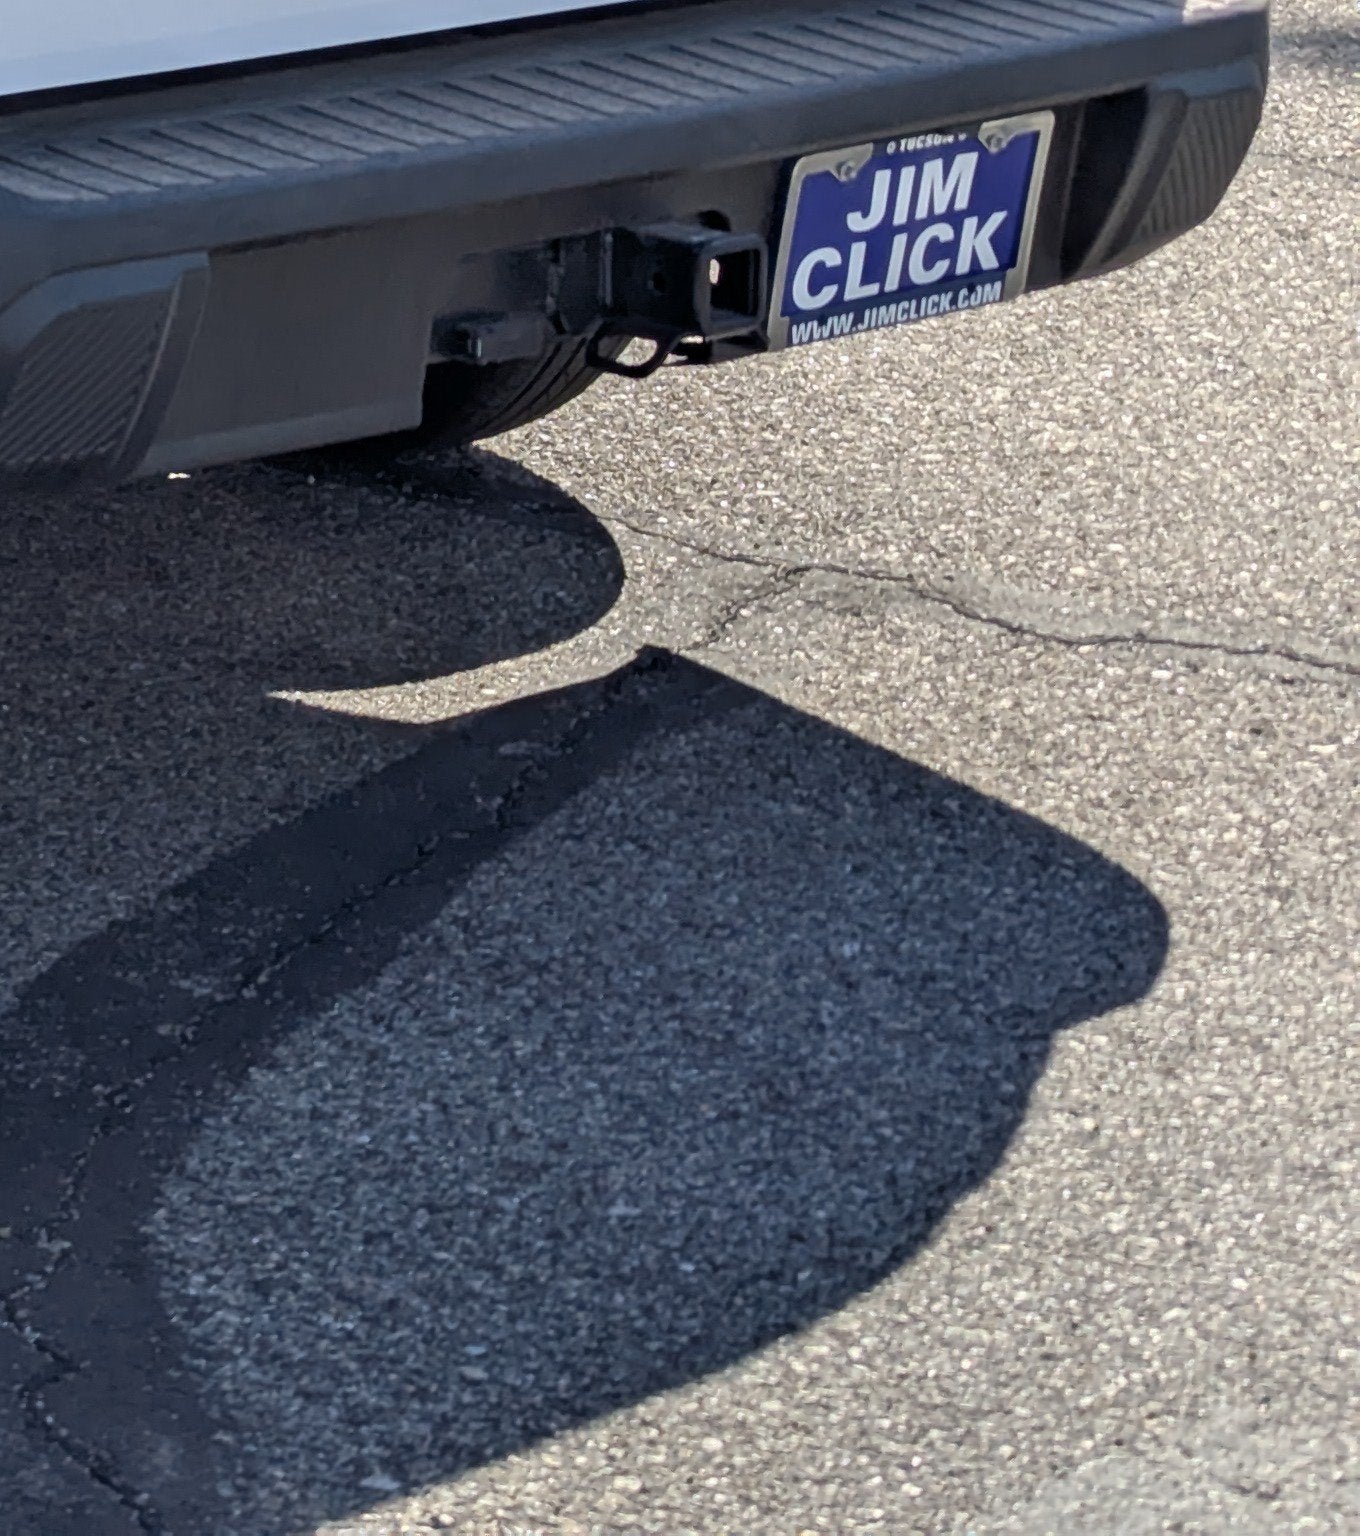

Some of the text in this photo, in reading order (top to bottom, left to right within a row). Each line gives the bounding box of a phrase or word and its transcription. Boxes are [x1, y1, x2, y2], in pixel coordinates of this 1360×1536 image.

[846, 151, 979, 234] JIM
[791, 210, 1008, 312] CLICK
[791, 280, 1003, 346] WWW.JIMCLICK.COM
